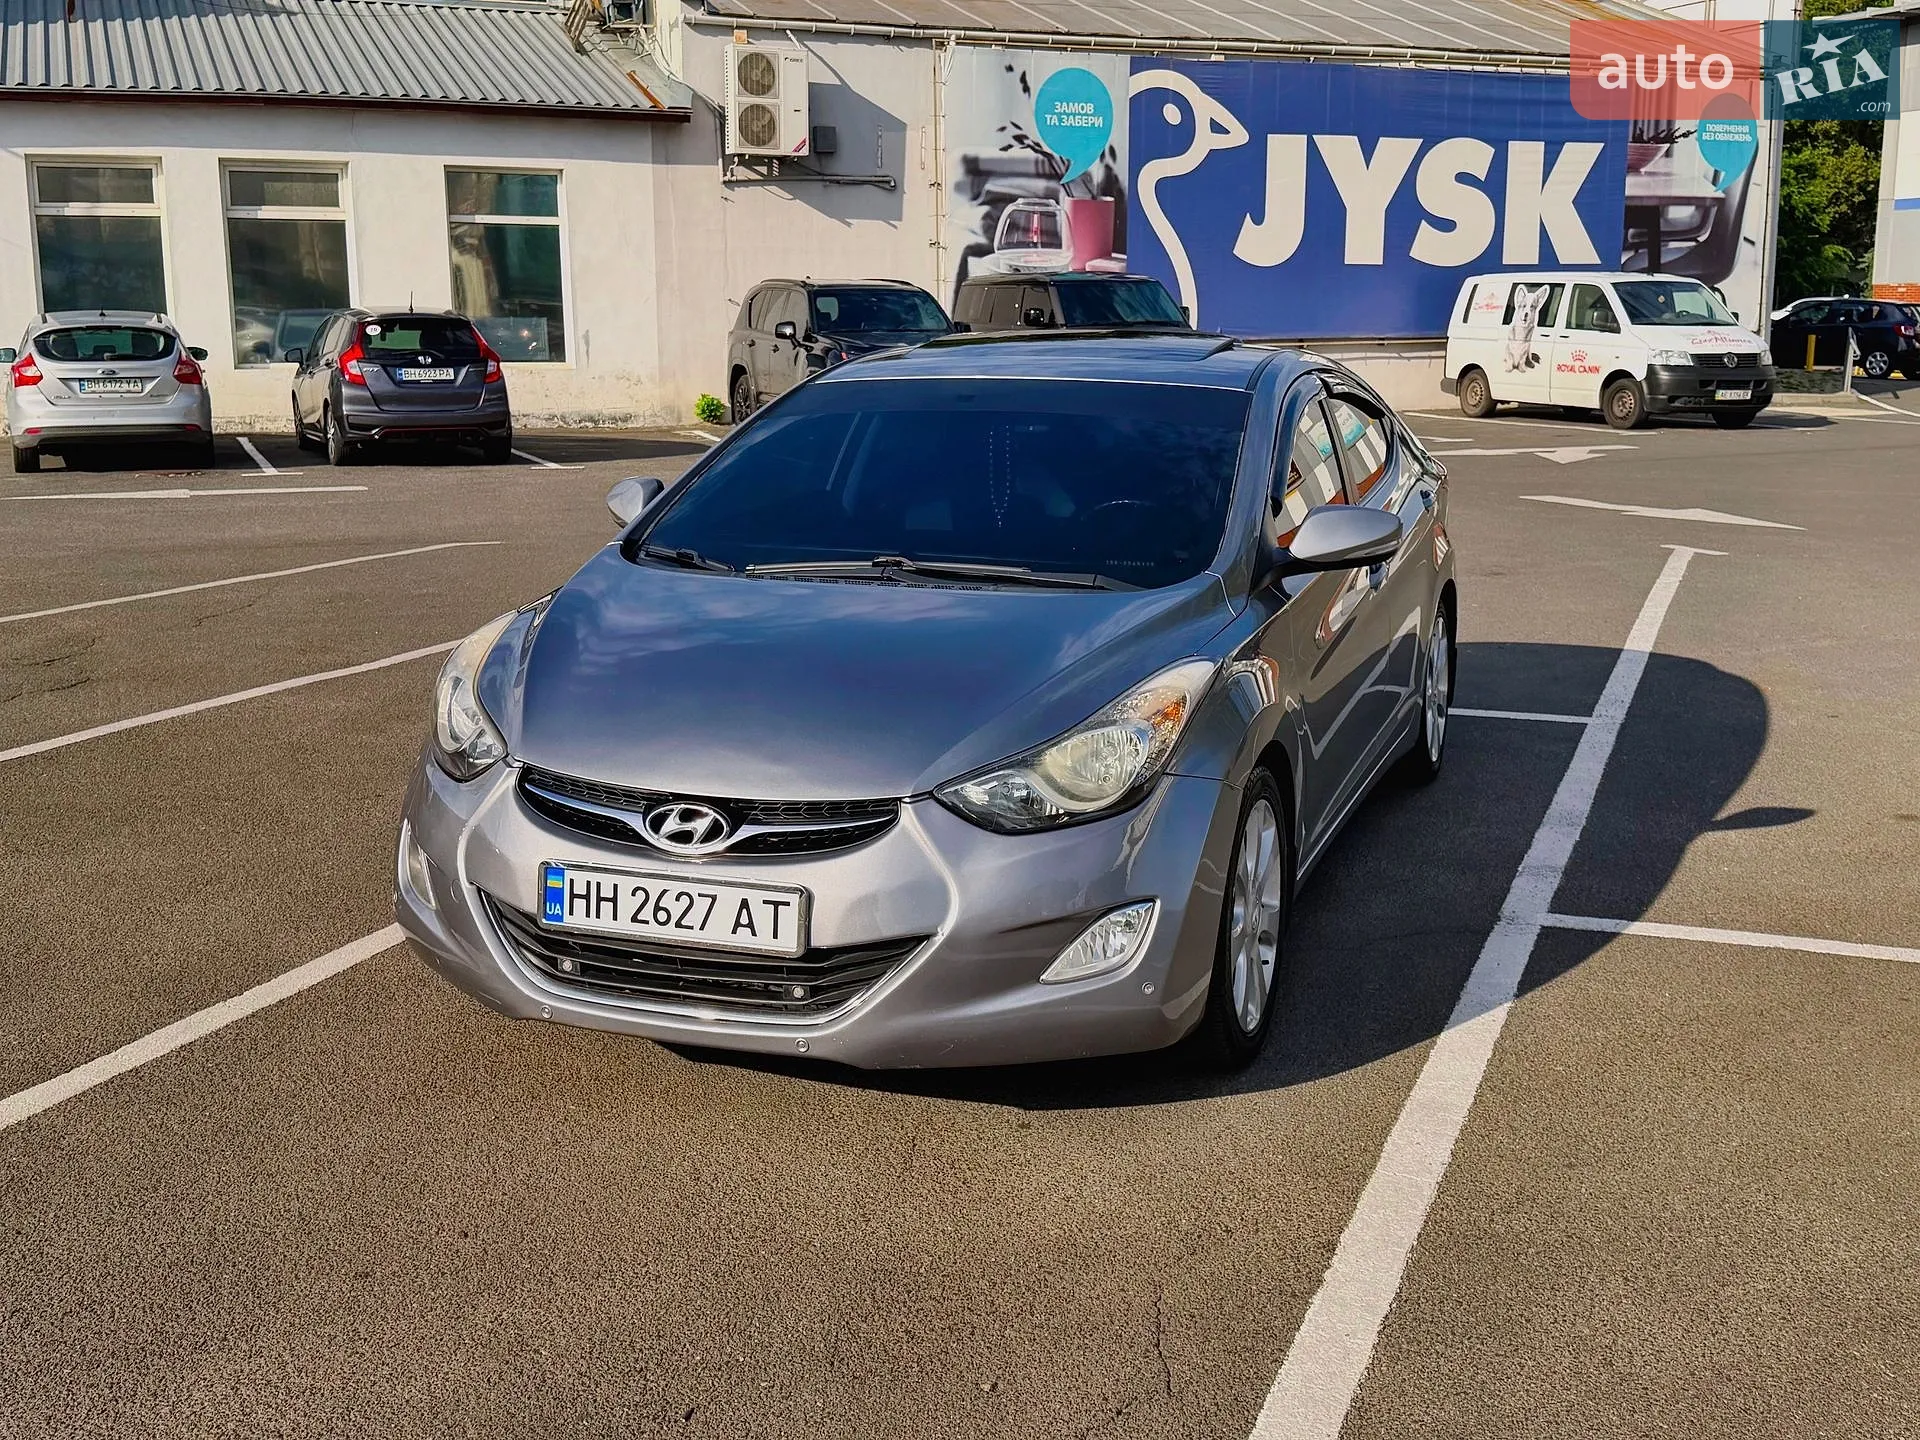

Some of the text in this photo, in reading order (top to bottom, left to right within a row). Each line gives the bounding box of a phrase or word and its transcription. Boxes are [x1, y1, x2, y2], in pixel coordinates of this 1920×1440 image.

[1053, 102, 1095, 114] ЗАМОВ
[1044, 114, 1104, 128] ТА ЗАБЕРИ
[1705, 123, 1750, 133] ПОВЕРНЕННЯ
[1702, 132, 1715, 141] БЕЗ
[1233, 133, 1606, 267] JYSK
[403, 369, 417, 379] BH
[439, 368, 452, 378] PA
[86, 379, 100, 389] BH
[102, 379, 124, 389] 6172
[546, 901, 562, 917] UA
[568, 878, 791, 940] HH 2627 AT
